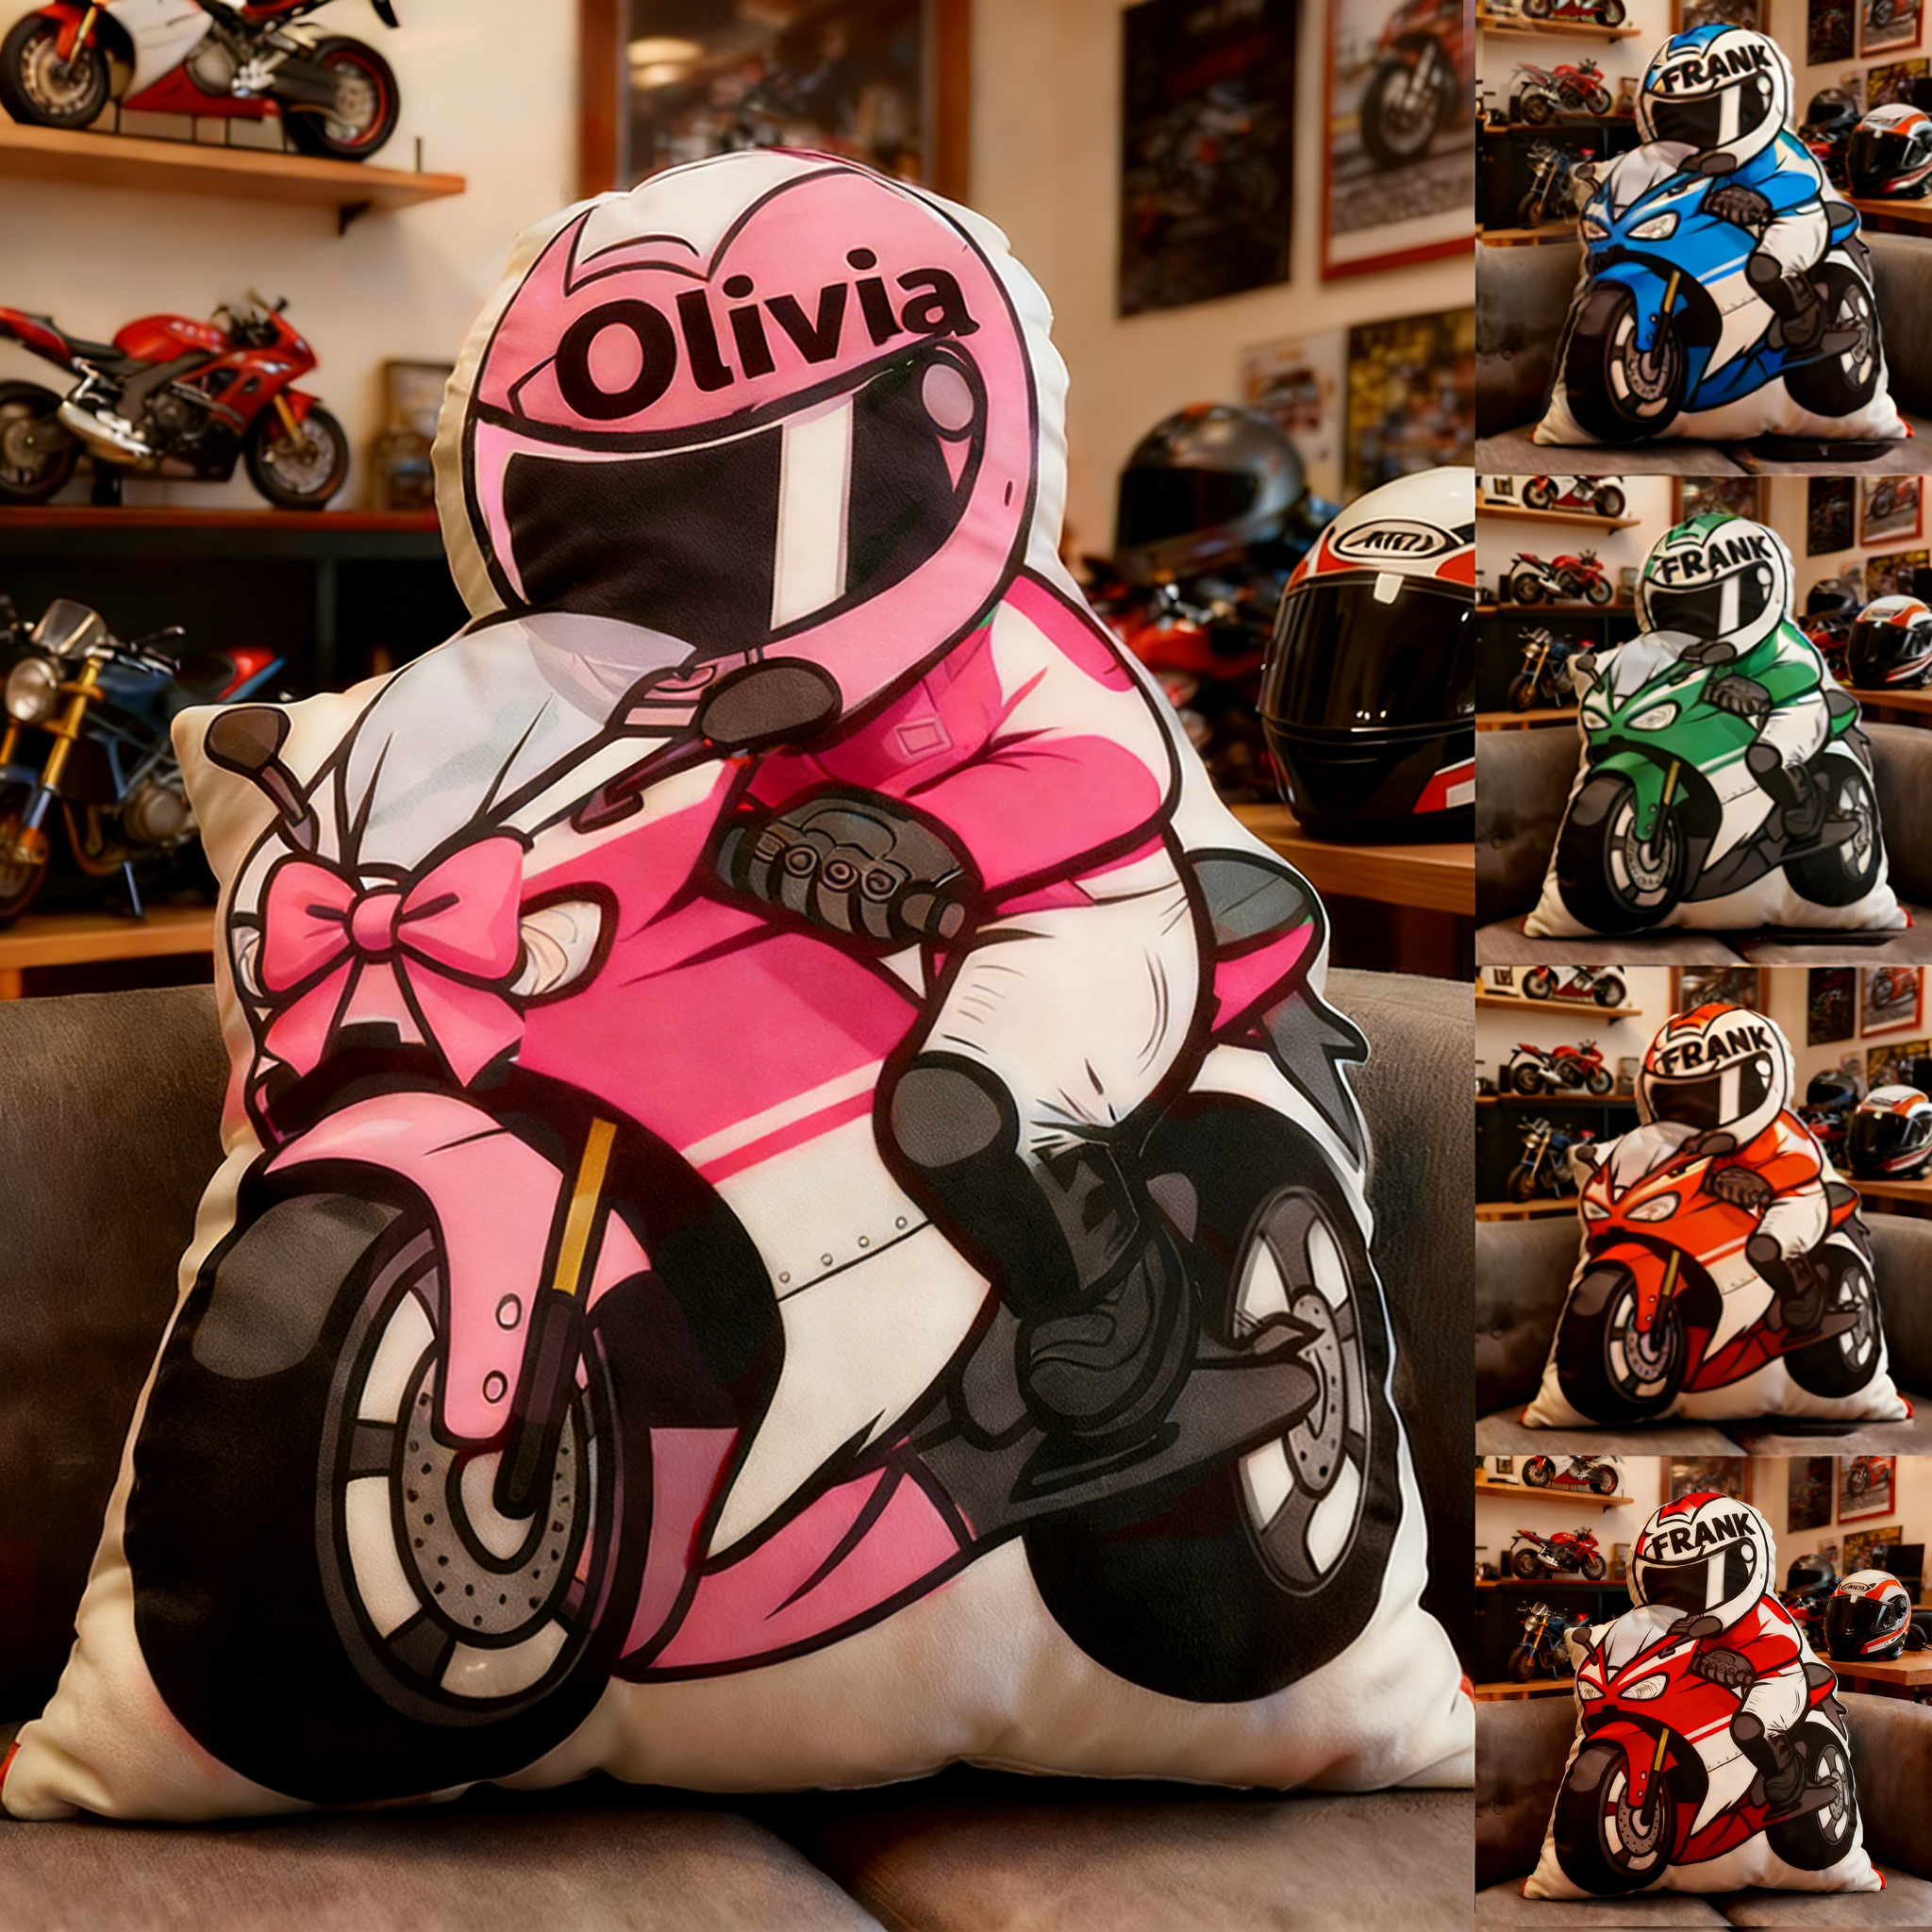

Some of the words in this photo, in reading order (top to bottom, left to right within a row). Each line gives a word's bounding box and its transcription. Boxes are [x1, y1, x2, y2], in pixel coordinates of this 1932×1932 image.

[1661, 44, 1773, 93] FRANK
[555, 247, 980, 420] Olivia
[1660, 535, 1773, 584] FRANK
[1661, 1025, 1773, 1074] FRANK
[1651, 1512, 1757, 1560] FRANK
